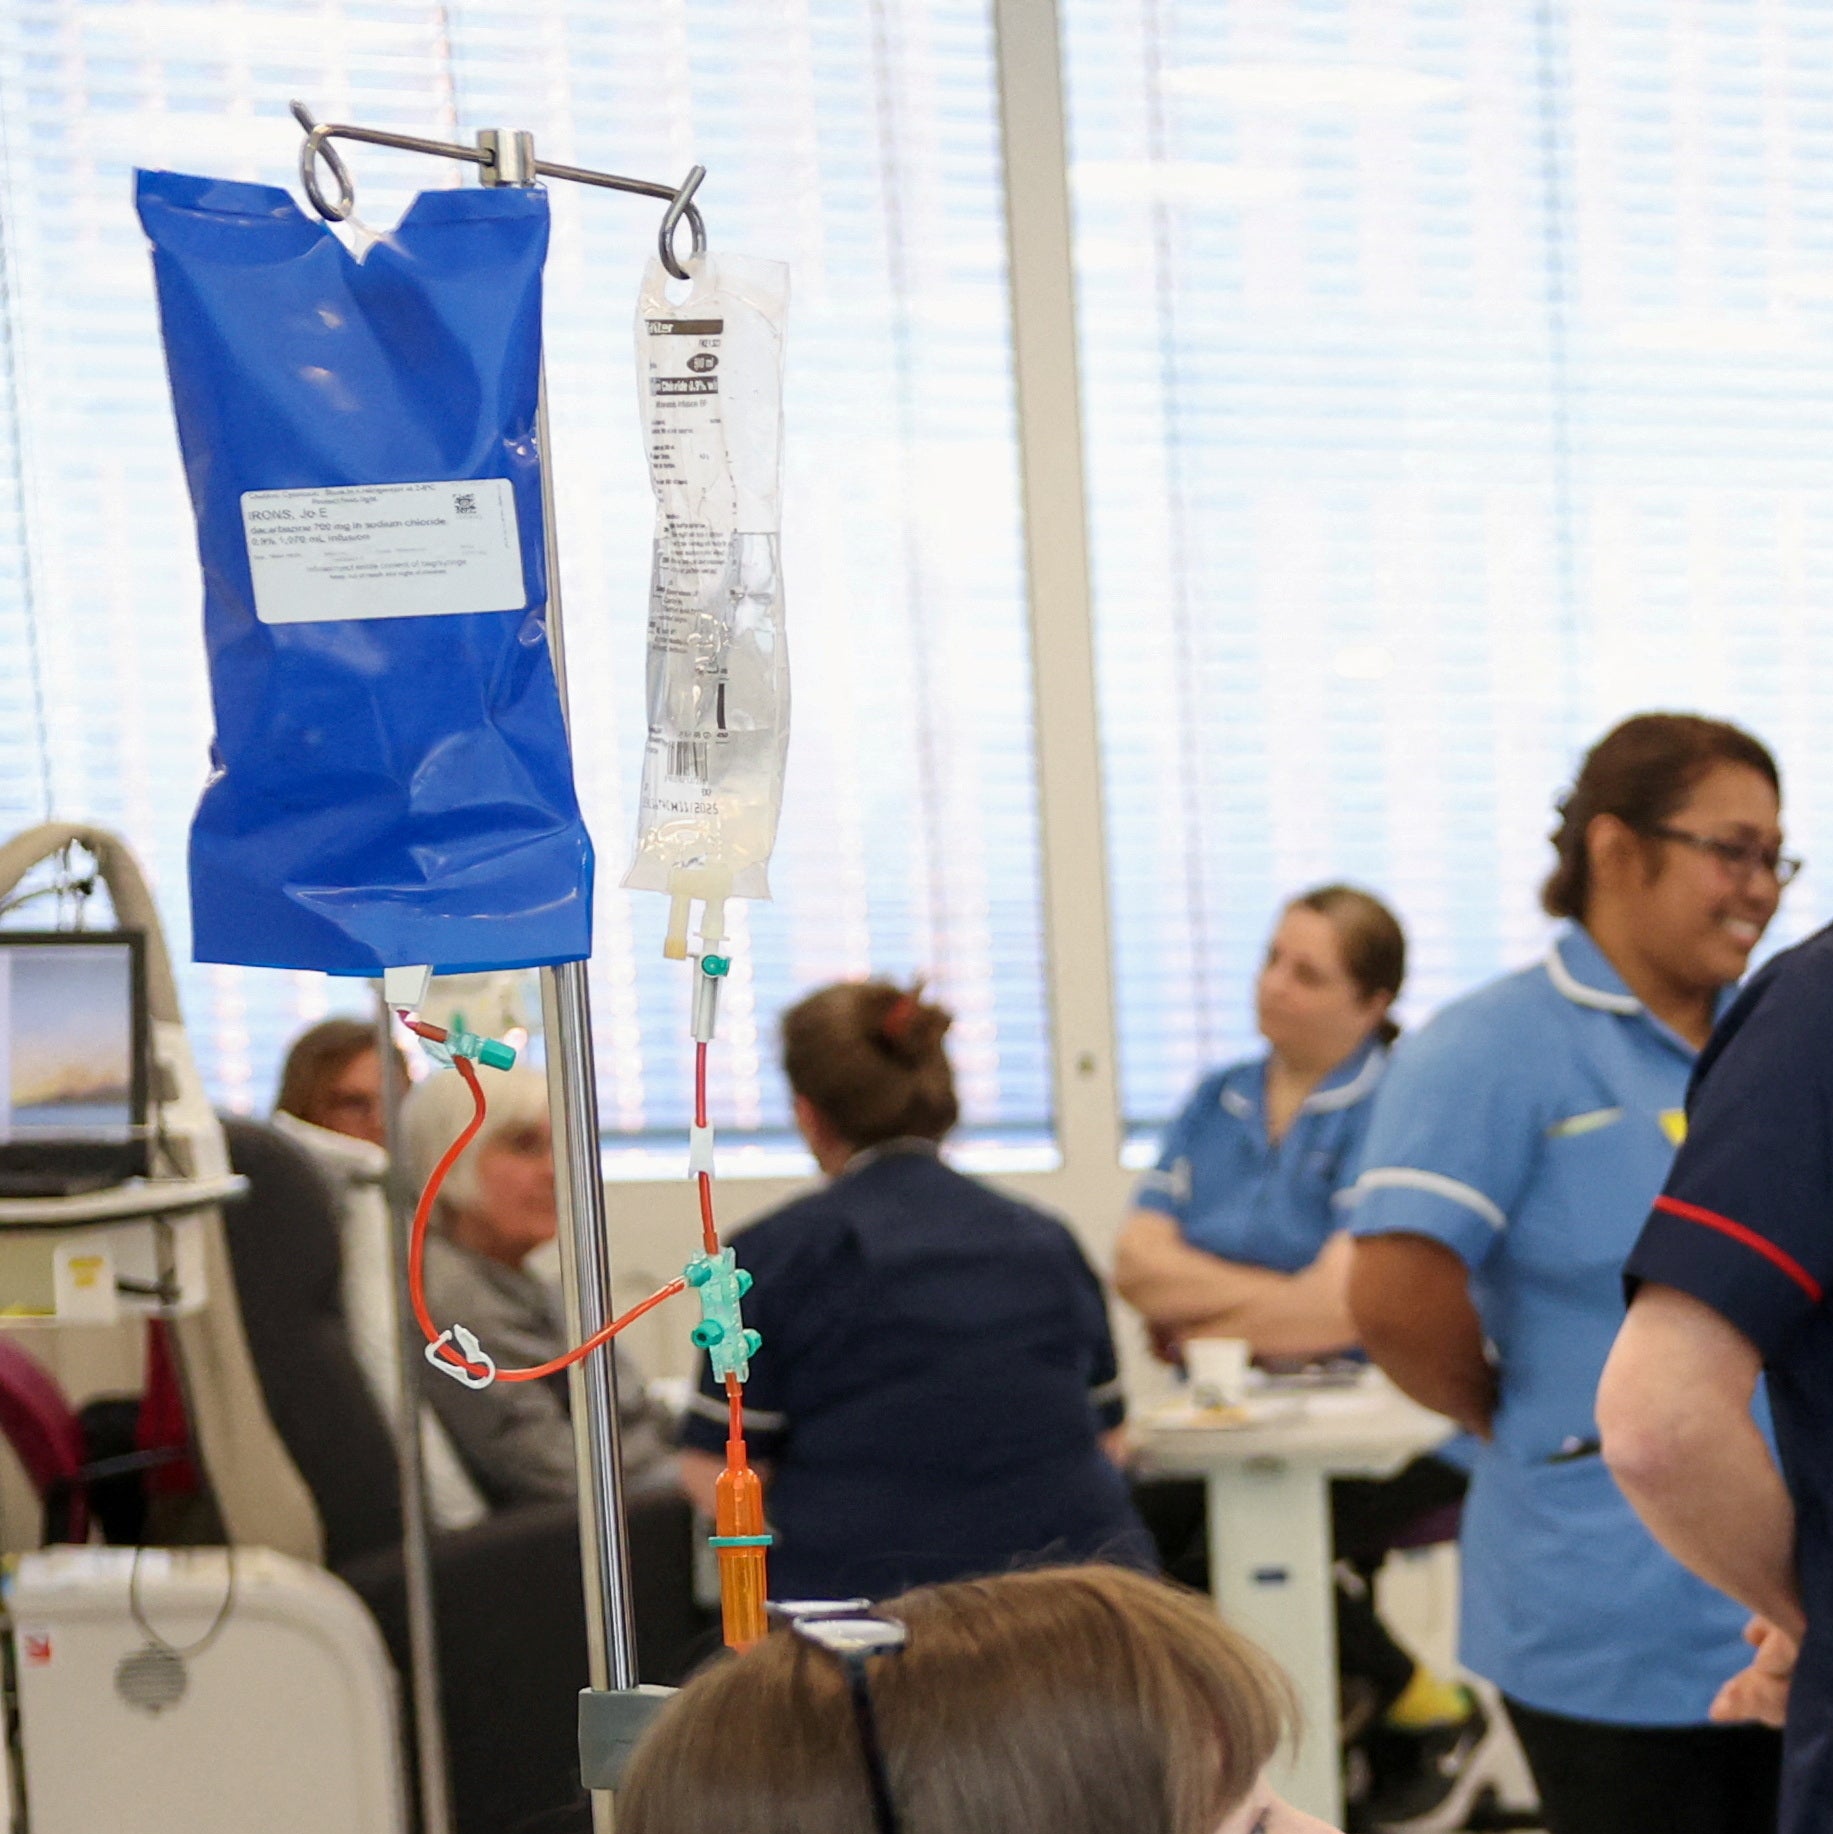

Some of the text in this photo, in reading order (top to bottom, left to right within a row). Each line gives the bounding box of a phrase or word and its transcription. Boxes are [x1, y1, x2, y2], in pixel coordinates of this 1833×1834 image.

[319, 507, 328, 518] E
[365, 519, 402, 529] sodium
[404, 517, 446, 527] chloride
